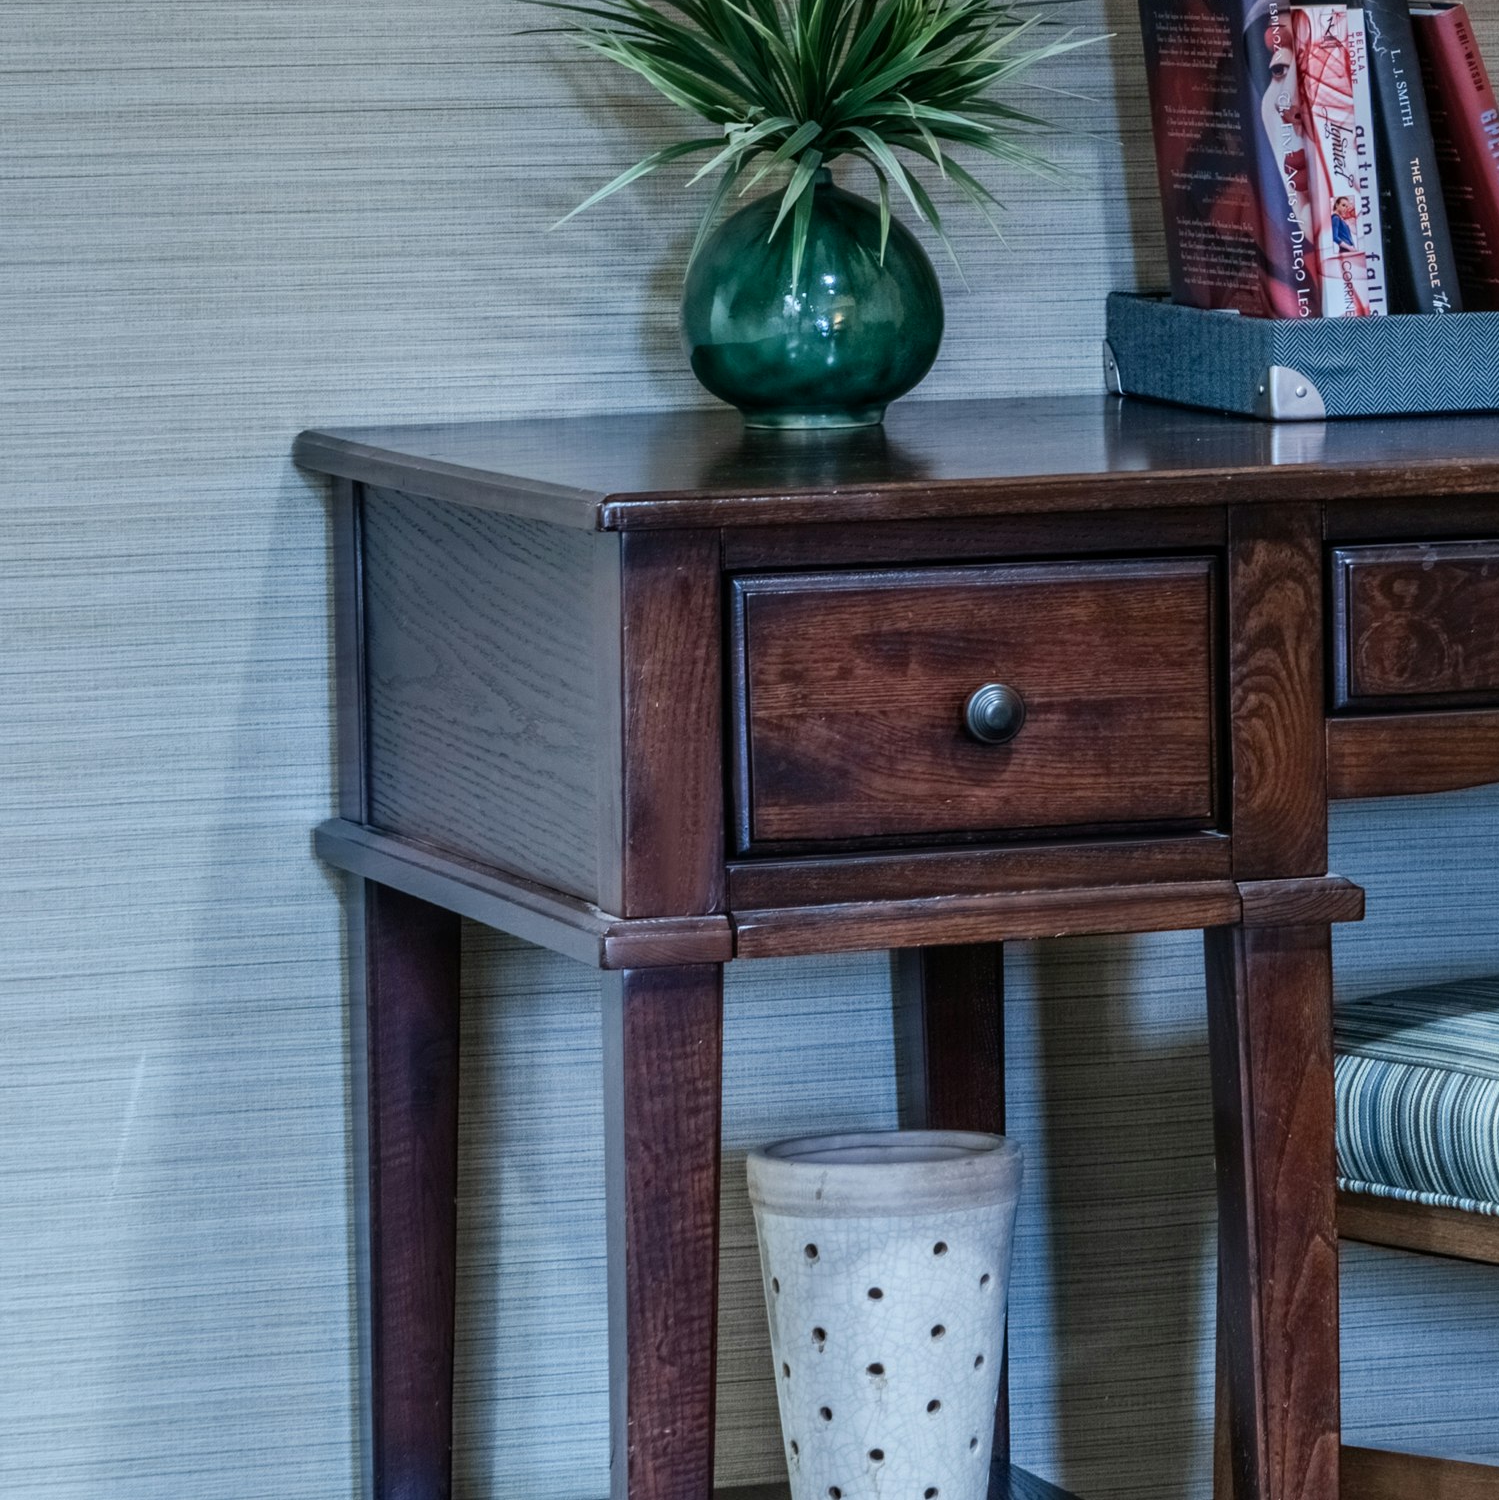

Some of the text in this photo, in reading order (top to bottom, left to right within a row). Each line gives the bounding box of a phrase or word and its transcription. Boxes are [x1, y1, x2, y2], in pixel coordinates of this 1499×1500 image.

[1348, 31, 1359, 85] THORNE
[1355, 31, 1366, 72] BELLA
[1396, 80, 1414, 128] SMITH
[1355, 125, 1373, 236] autumn
[1409, 156, 1441, 288] THE SECRET CIRCLE
